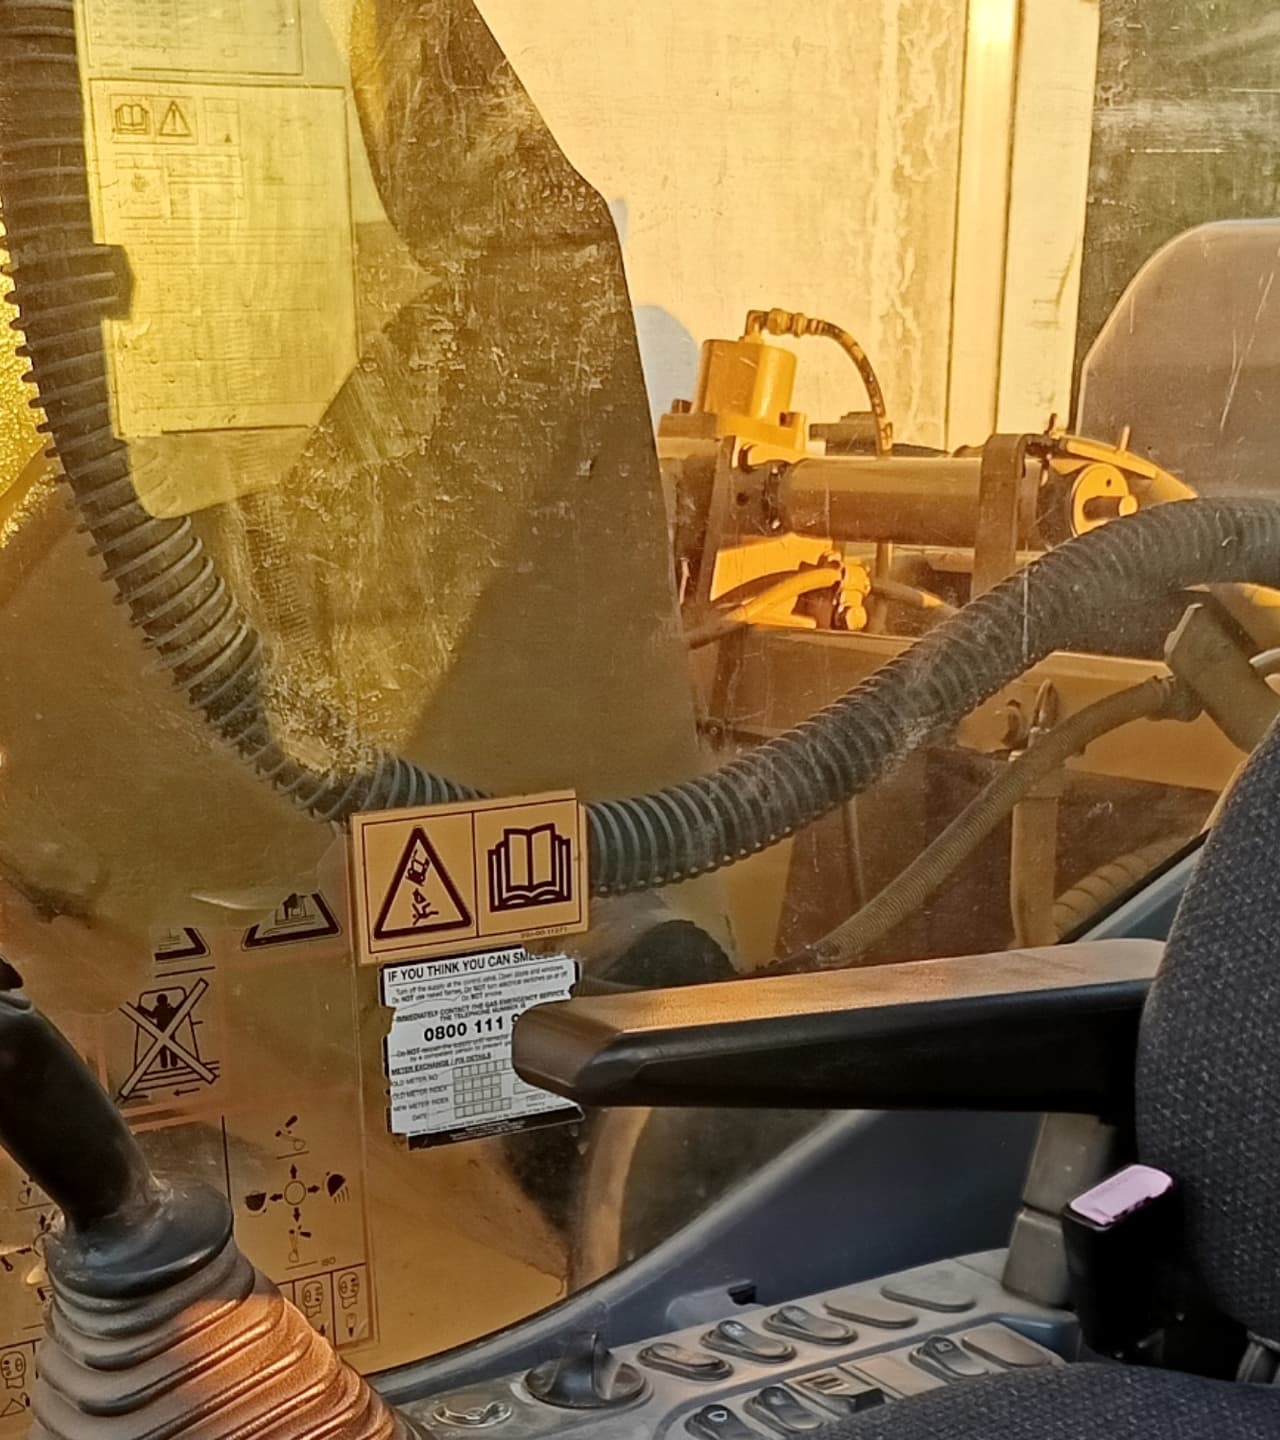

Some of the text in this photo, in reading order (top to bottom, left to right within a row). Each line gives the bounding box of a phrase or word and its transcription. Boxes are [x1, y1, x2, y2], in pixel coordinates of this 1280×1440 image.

[388, 952, 510, 982] IF YOU THINK YOU CAN
[424, 1022, 467, 1042] 0800
[474, 1016, 502, 1034] 111
